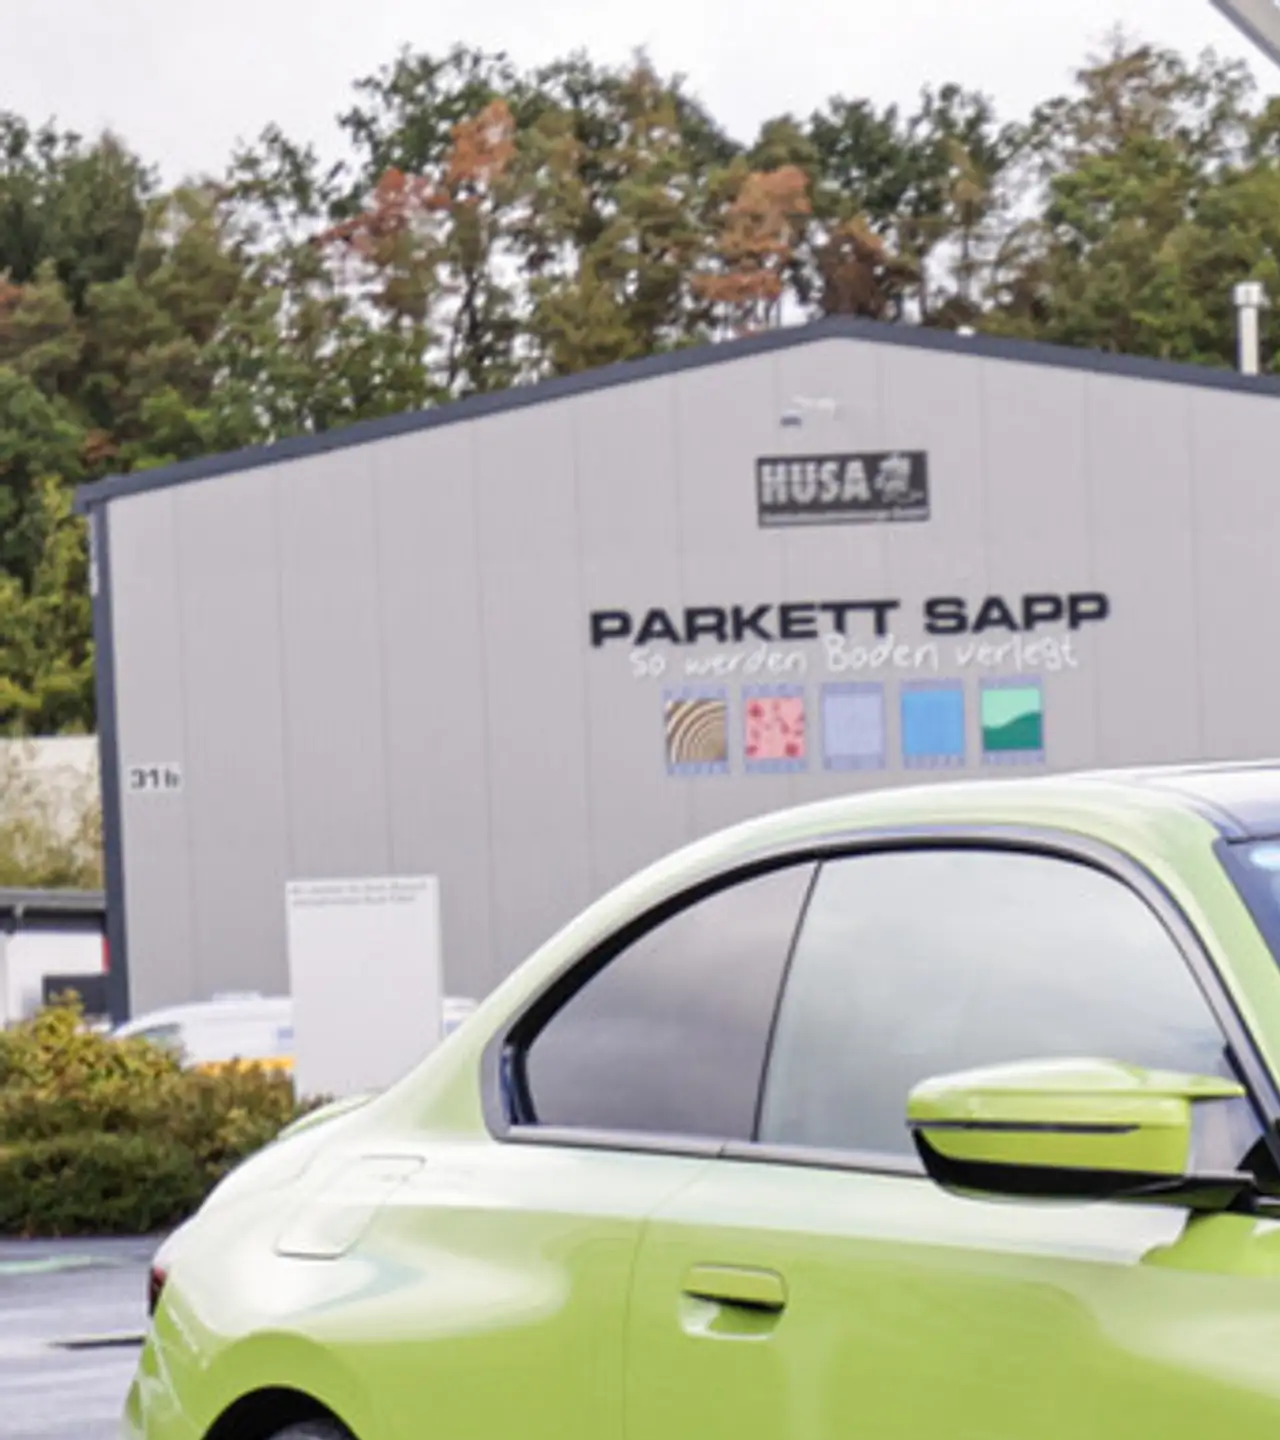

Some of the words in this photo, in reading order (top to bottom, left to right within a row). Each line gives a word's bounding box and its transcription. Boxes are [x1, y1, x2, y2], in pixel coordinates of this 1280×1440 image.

[761, 458, 871, 505] HUSA
[591, 600, 899, 647] PARKETT
[924, 591, 1109, 634] SAPP
[629, 649, 666, 677] So
[684, 643, 808, 676] werden
[956, 632, 1078, 672] verlegt
